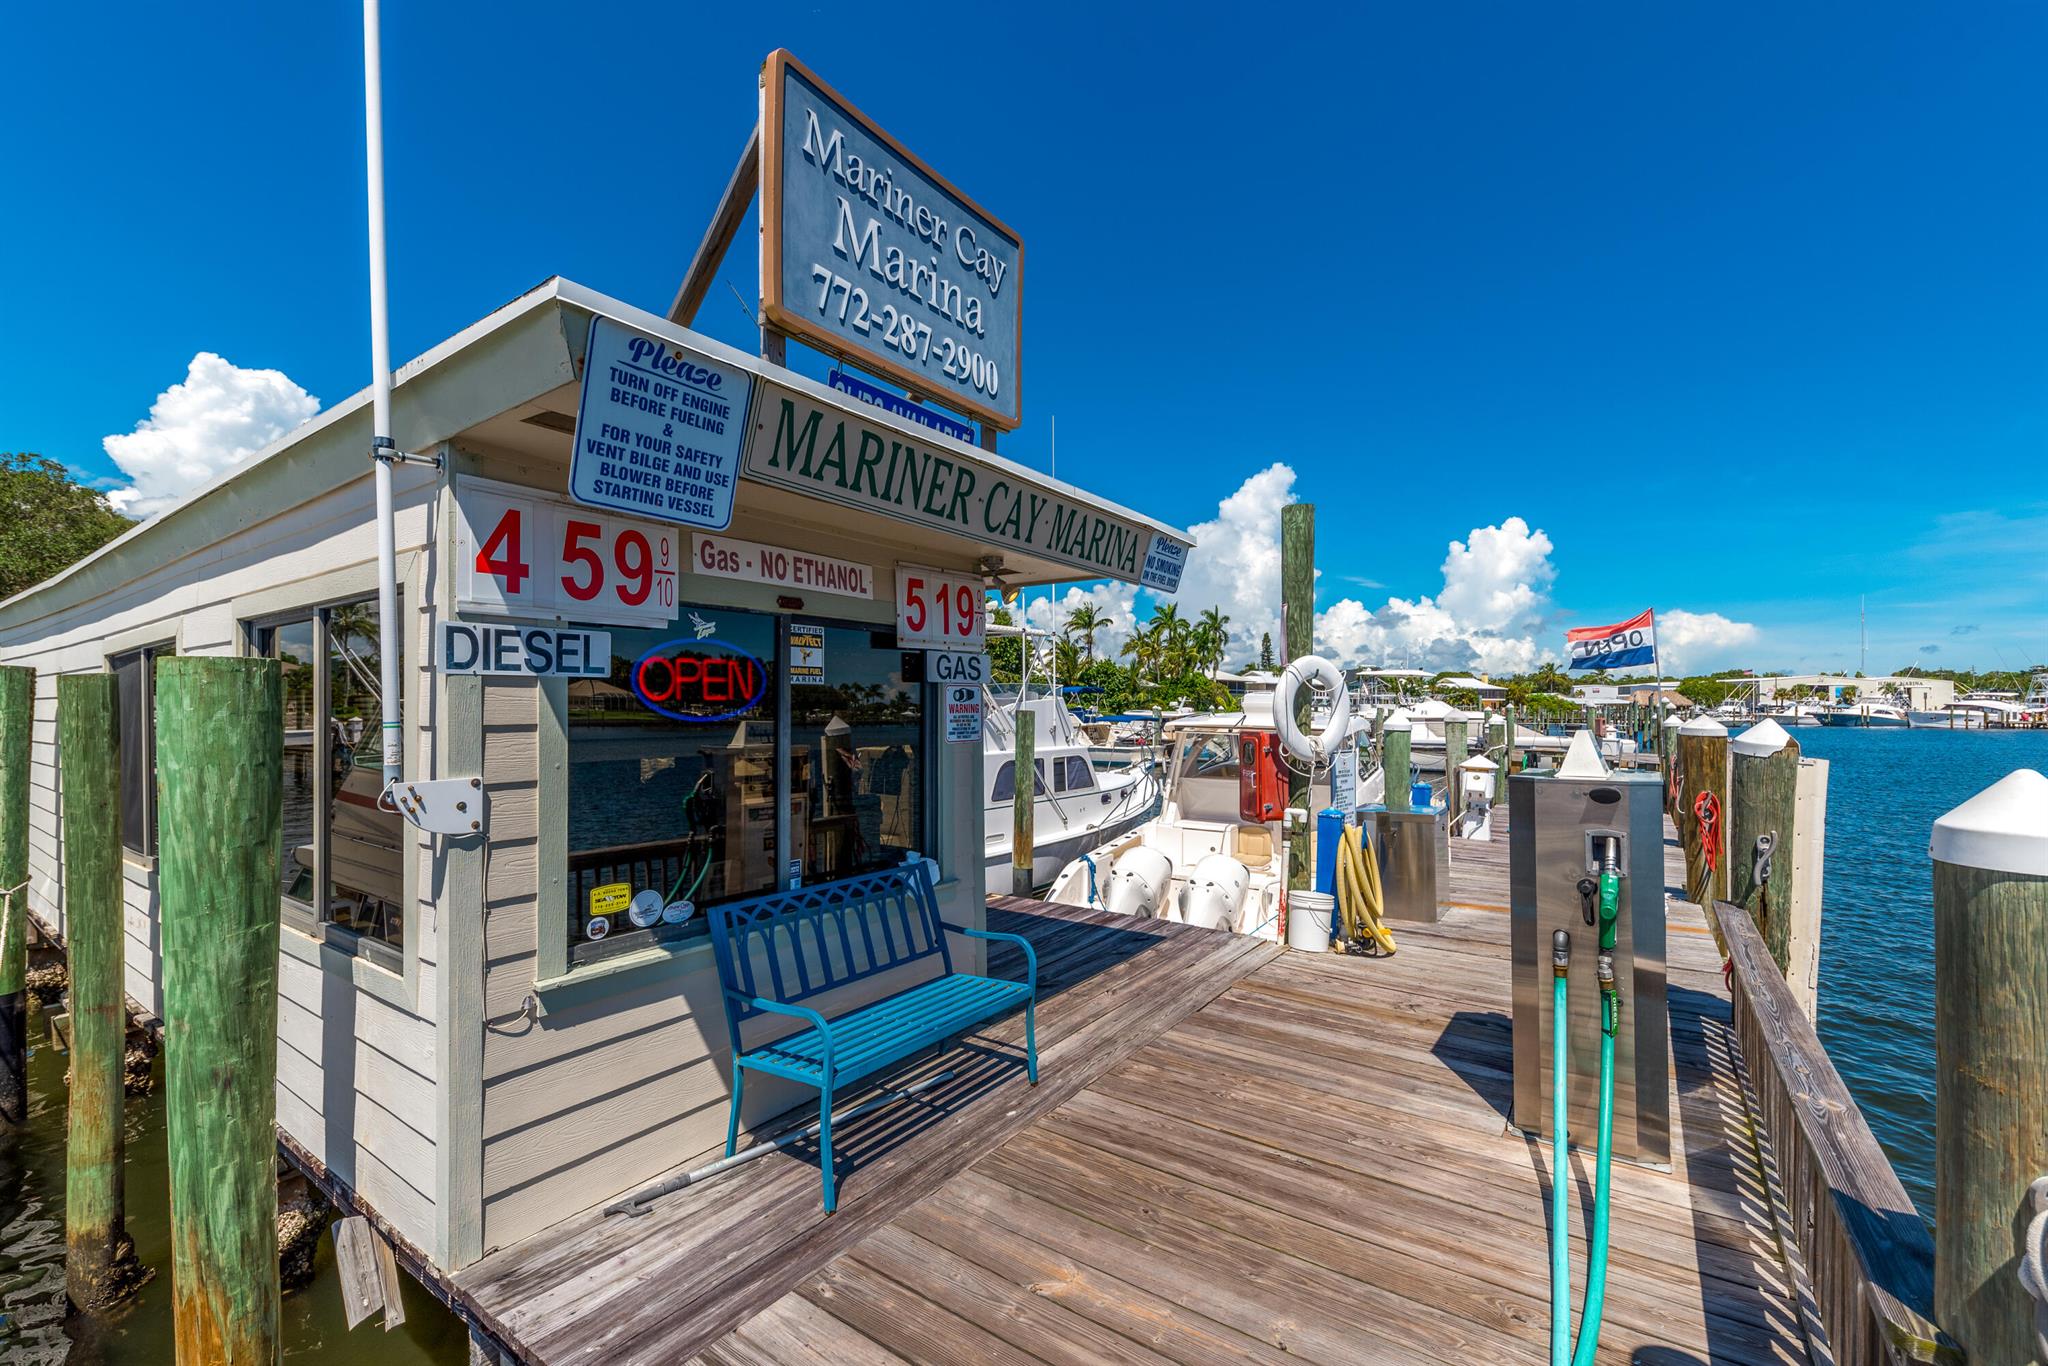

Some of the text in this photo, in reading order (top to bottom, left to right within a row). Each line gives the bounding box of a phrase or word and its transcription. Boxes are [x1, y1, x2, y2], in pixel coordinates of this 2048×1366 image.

[802, 107, 1007, 294] Mariner Cay
[833, 196, 984, 335] Marina
[812, 262, 999, 396] 772-287-2900
[628, 337, 722, 391] Please
[609, 367, 731, 420] TURN OFF ENGINE
[610, 387, 725, 435] BEFORE FUELING
[601, 423, 723, 469] FOR YOUR SAFETY
[663, 423, 674, 437] &
[586, 438, 730, 488] VENT BILGE AND USE
[599, 462, 715, 501] BLOWER BEFORE
[768, 398, 1138, 574] MARINER CAY MARINA
[593, 480, 715, 518] STARTING VESSEL
[475, 508, 529, 594] 4
[560, 520, 653, 606] 59
[700, 540, 739, 573] Gas
[760, 550, 788, 581] NO
[793, 557, 868, 594] ETHANOL
[1146, 555, 1182, 577] NO SMOKING
[1156, 536, 1182, 557] Please
[445, 625, 606, 674] DIESEL
[936, 654, 981, 681] GAS
[638, 655, 754, 702] OPEN
[948, 703, 980, 714] WARNING
